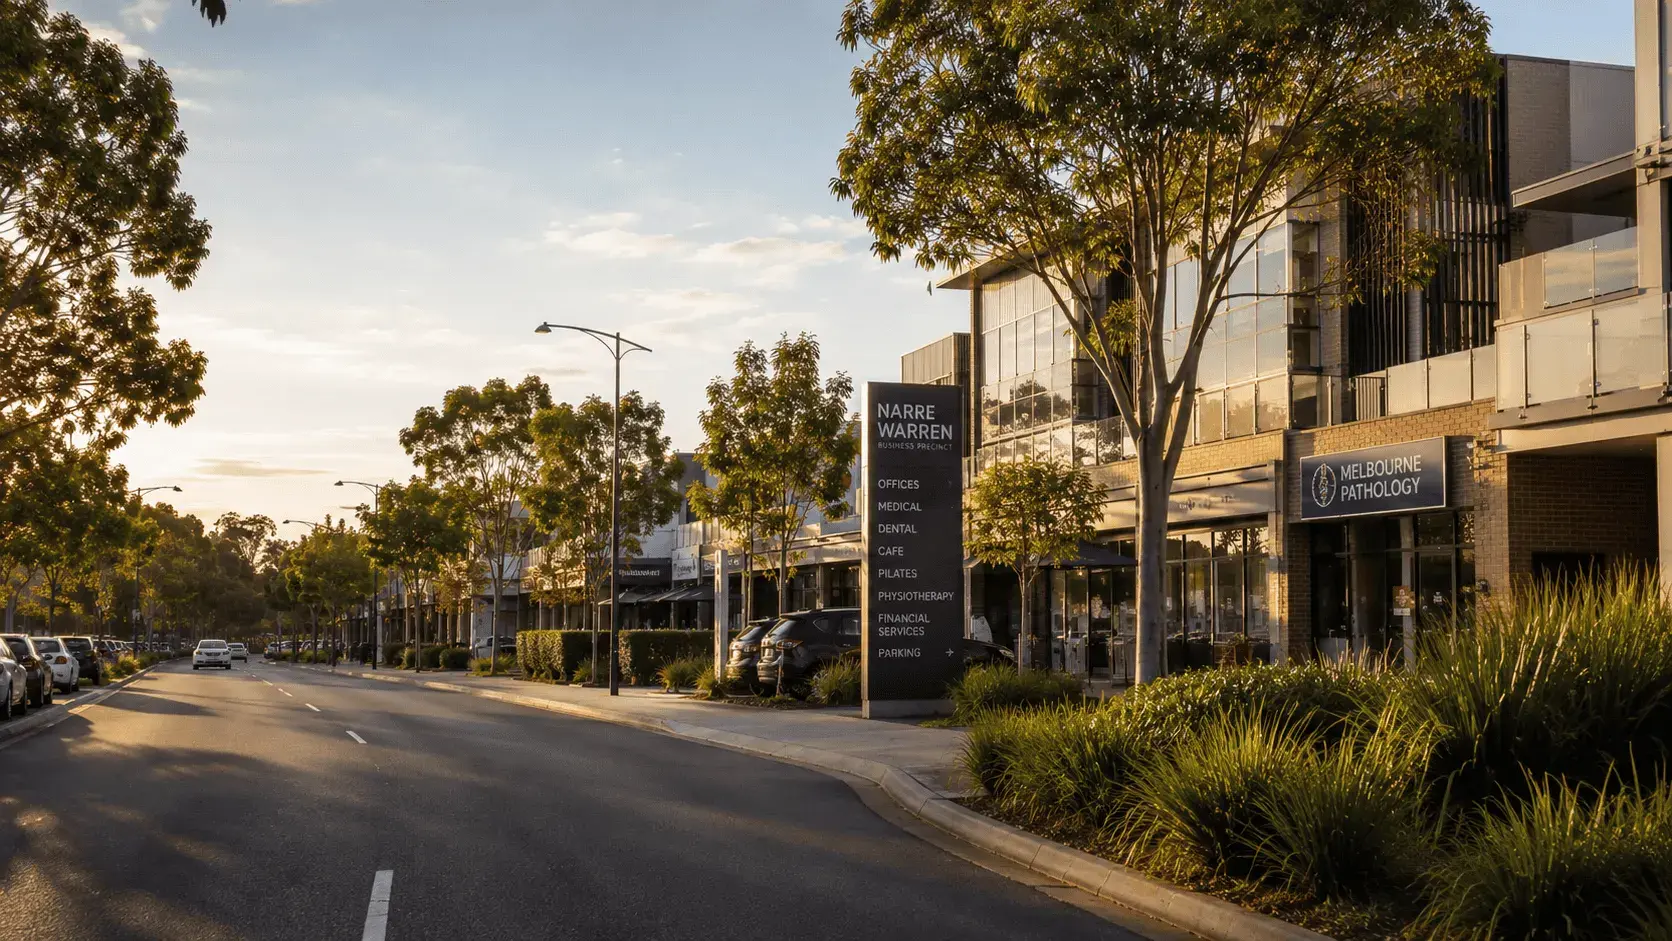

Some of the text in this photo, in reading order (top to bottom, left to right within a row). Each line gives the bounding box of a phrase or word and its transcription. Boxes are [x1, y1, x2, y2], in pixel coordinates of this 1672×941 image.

[878, 402, 936, 420] NARRE
[877, 422, 953, 440] WARREN
[877, 441, 953, 451] BUSINESS PRECINCT
[1340, 454, 1422, 480] MELBOURNE
[877, 479, 920, 490] OFFICES
[1340, 476, 1421, 502] PATHOLOGY
[877, 501, 922, 512] MEDICAL
[878, 523, 918, 534] DENTAL
[877, 546, 904, 557] CAFE
[878, 568, 918, 579] PILATES
[878, 591, 955, 602] PHYSIOTHERAPY
[878, 613, 931, 624] FINANCIAL
[878, 626, 925, 637] SERVICES
[878, 648, 921, 658] PARKING
